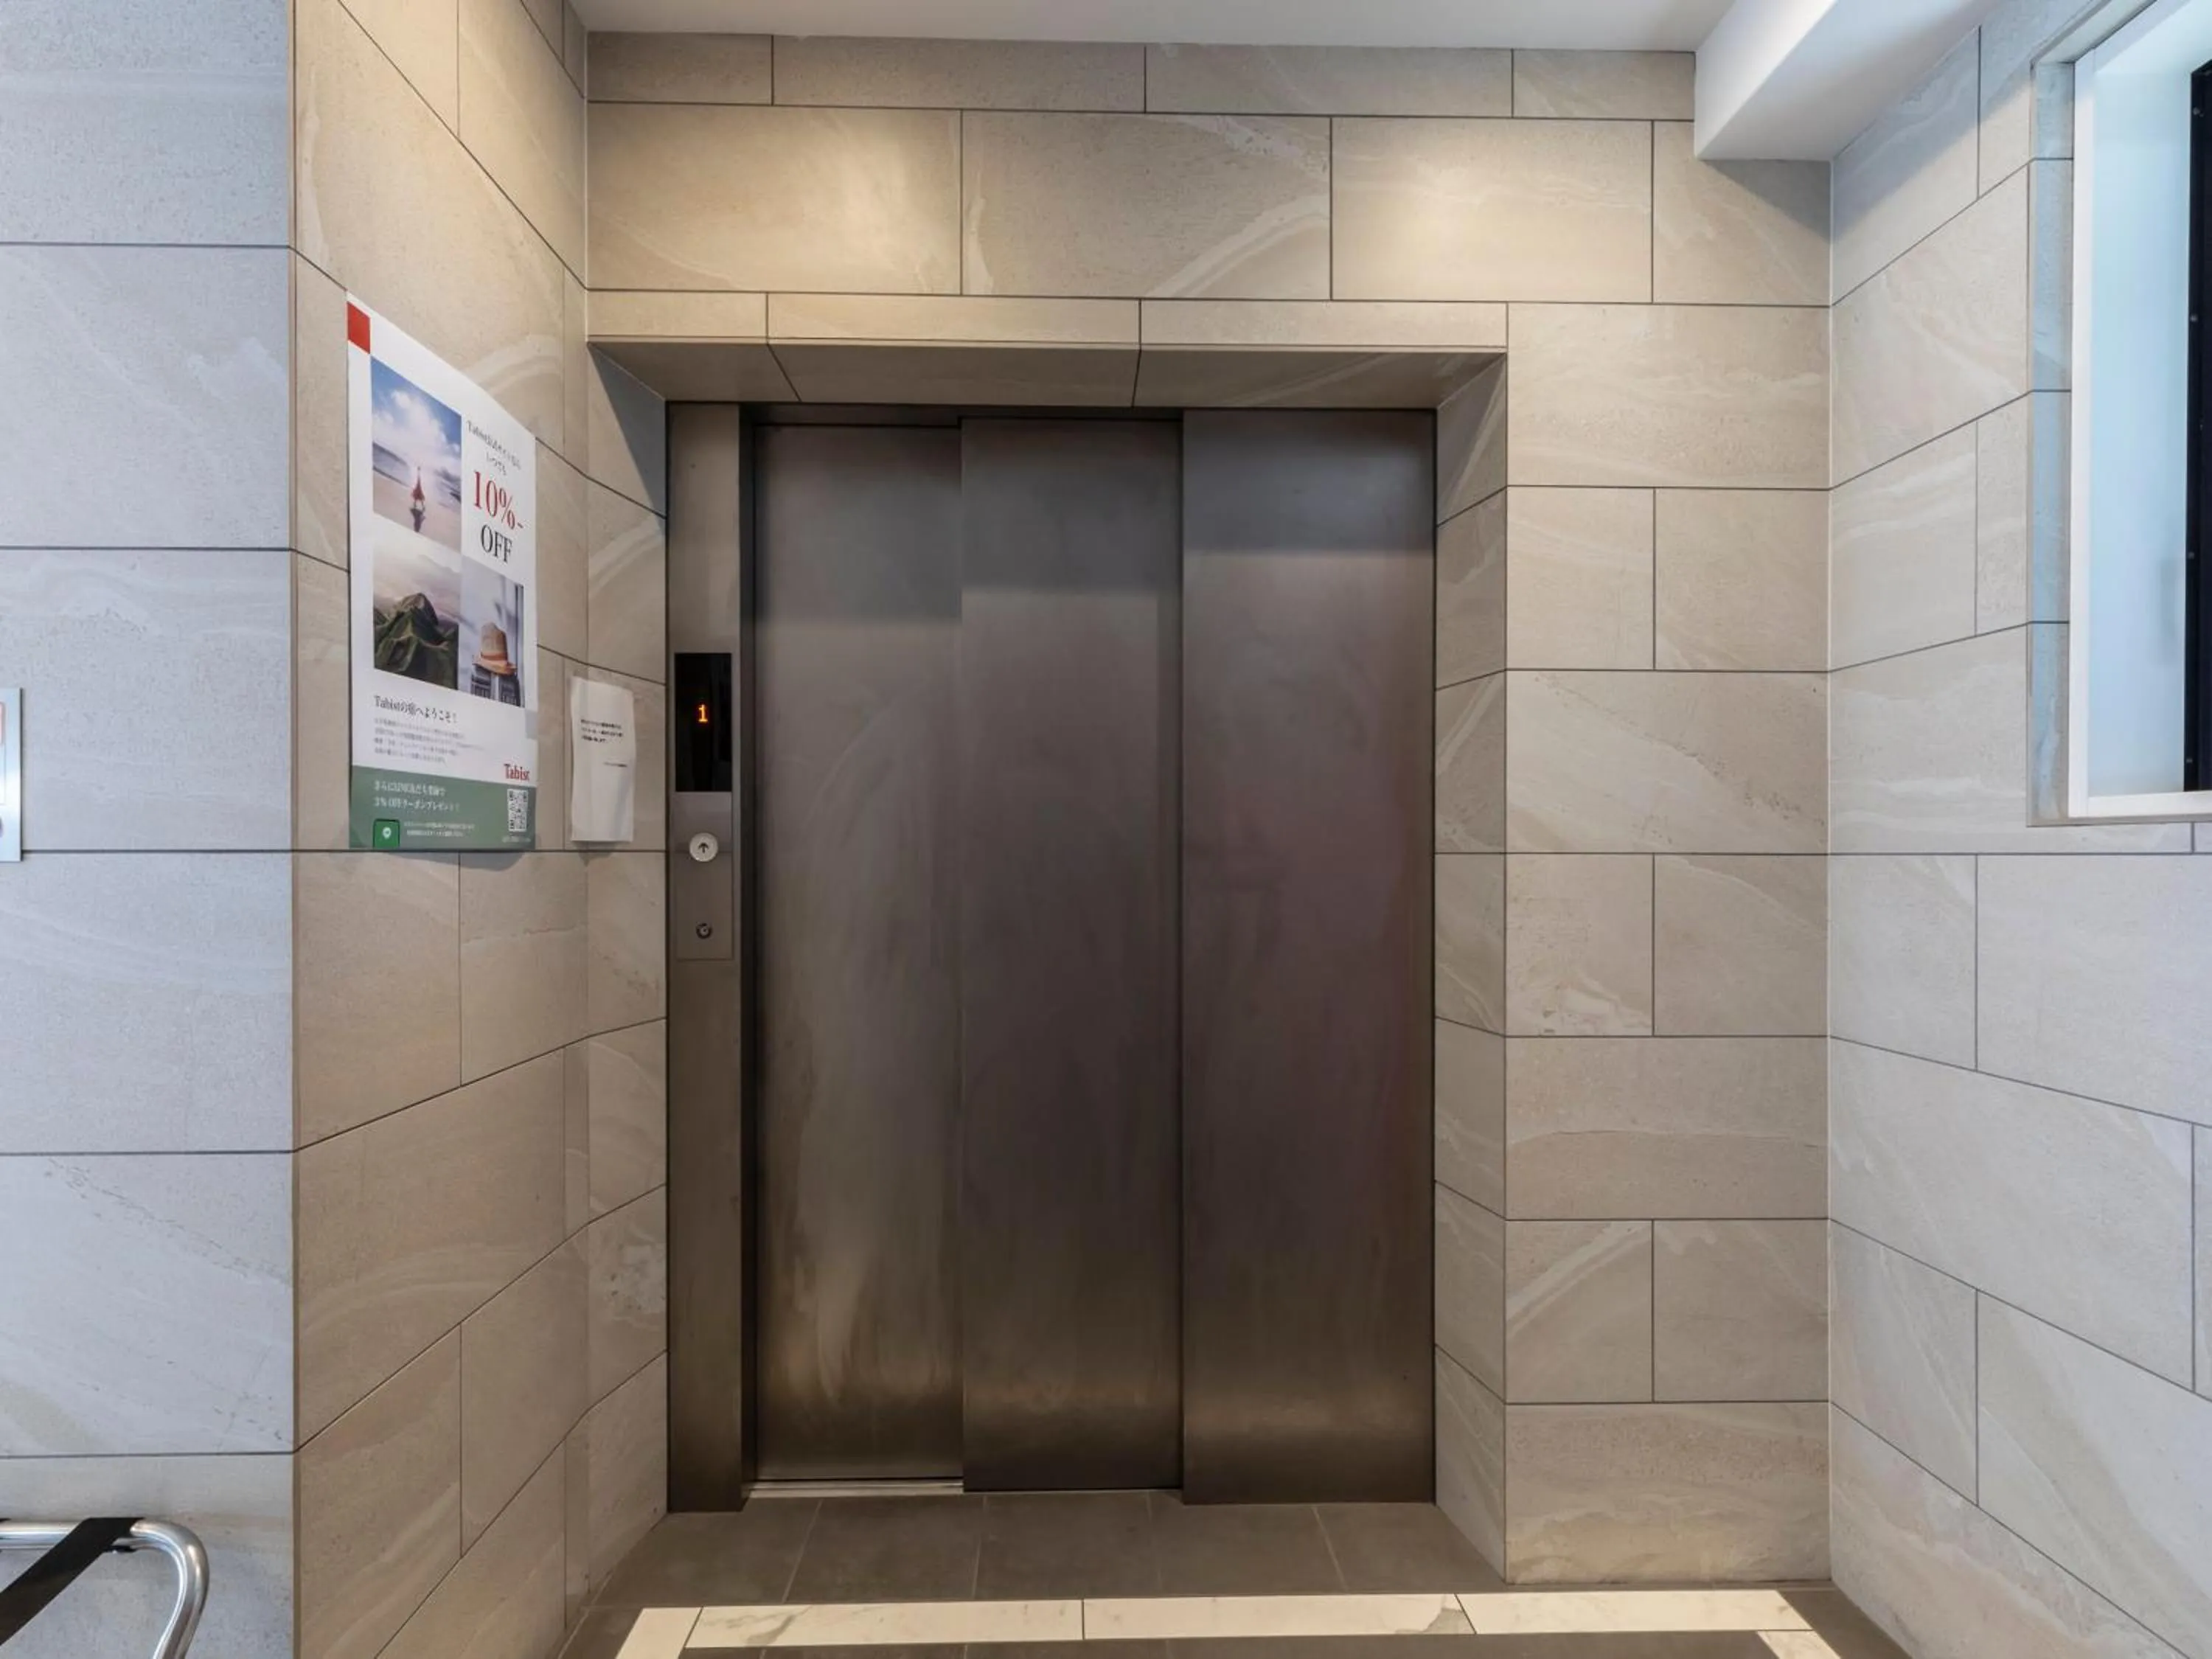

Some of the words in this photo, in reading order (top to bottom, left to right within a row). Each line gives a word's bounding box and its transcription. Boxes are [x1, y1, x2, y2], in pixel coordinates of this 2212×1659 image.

[481, 524, 512, 563] OFF
[698, 703, 709, 723] 1
[504, 764, 529, 781] Tabist
